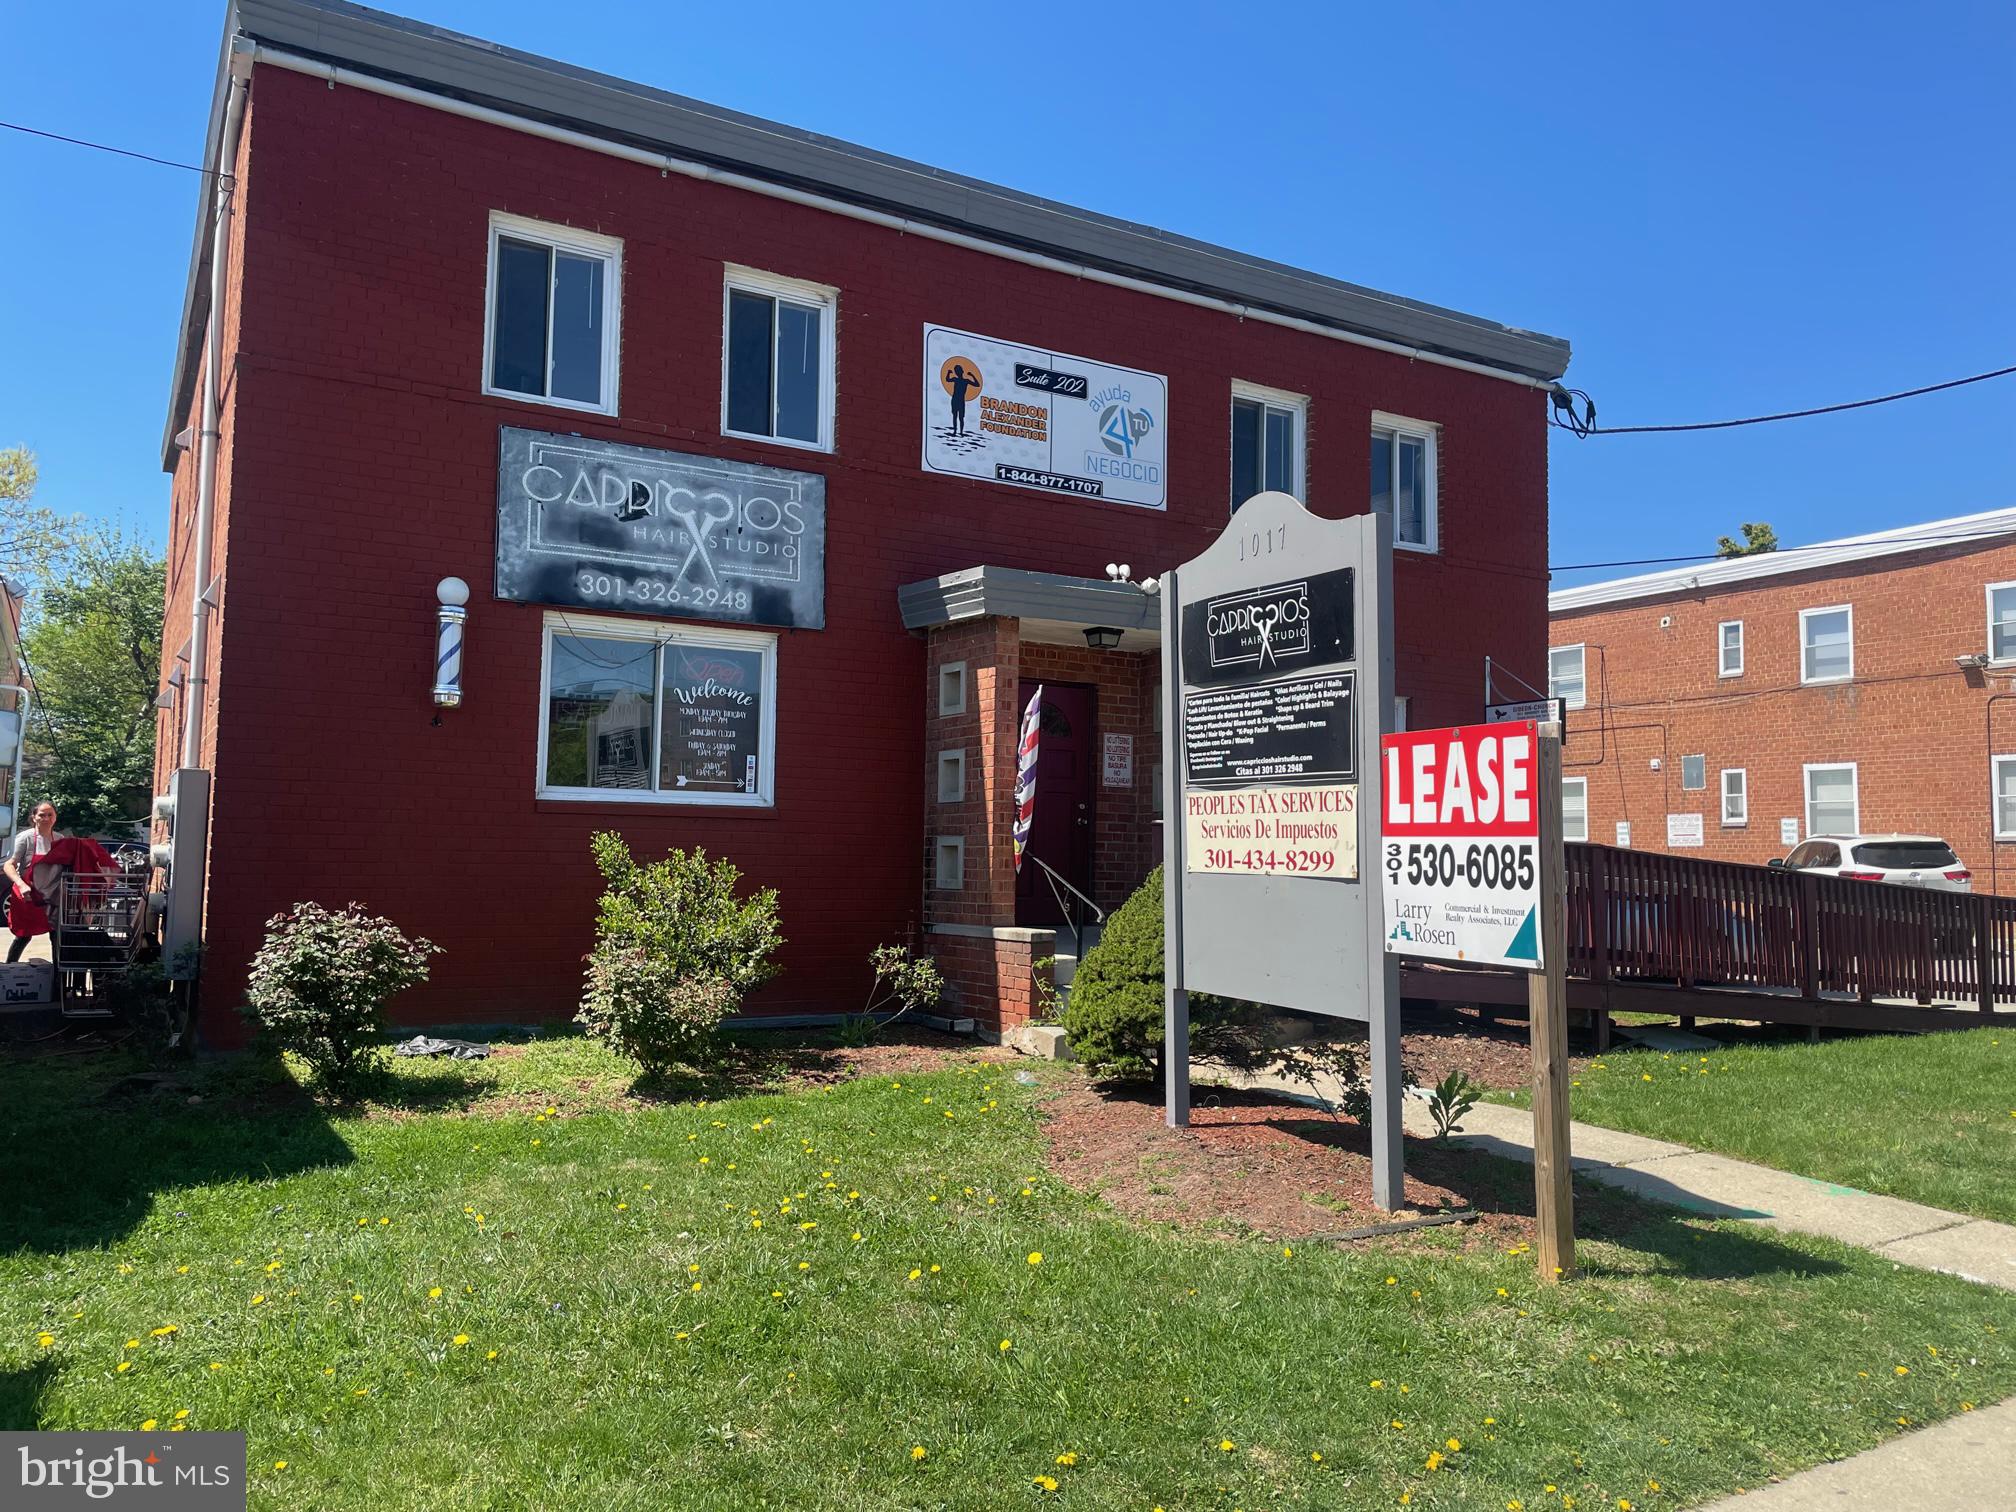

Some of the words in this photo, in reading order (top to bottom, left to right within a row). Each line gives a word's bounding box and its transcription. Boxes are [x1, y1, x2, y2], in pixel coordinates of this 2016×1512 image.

[1016, 368, 1050, 386] Suite
[1055, 378, 1085, 394] 202
[980, 396, 1048, 420] BRANDON
[1089, 384, 1131, 412] ayuda
[980, 409, 1047, 431] ALEXANDER
[1132, 419, 1148, 432] TU
[979, 421, 1047, 442] FOUNDATION
[1087, 455, 1159, 483] NEGOCIO
[998, 468, 1101, 494] 1-844-877-1707
[633, 526, 690, 545] HAIR
[708, 535, 797, 559] STUDIO
[1239, 523, 1286, 562] 1017
[580, 574, 748, 611] 301-326-2948
[1206, 596, 1311, 637] CAPRICCIOS
[1240, 635, 1262, 647] HAIR
[1268, 627, 1307, 643] STUDIO
[673, 677, 753, 706] Welcome
[1250, 689, 1271, 699] Haircuts
[1291, 691, 1317, 703] Highlights
[1317, 690, 1323, 699] &
[1323, 689, 1350, 699] Balayage
[1314, 681, 1324, 690] Gel
[1216, 712, 1224, 720] de
[1223, 711, 1239, 719] Botox
[1244, 708, 1263, 717] Keratin
[1243, 700, 1251, 708] de
[1292, 704, 1300, 713] up
[1300, 702, 1305, 710] &
[1304, 700, 1321, 710] Beard
[1321, 699, 1335, 708] Trim
[1233, 719, 1247, 727] Blow
[1246, 718, 1257, 726] out
[1261, 714, 1295, 725] Straightening
[1254, 725, 1269, 734] Facial
[1309, 720, 1327, 729] Perms
[1220, 738, 1232, 746] Cera
[1235, 767, 1253, 776] Citas
[1253, 766, 1261, 775] al
[1261, 765, 1274, 775] 301
[1274, 763, 1286, 774] 326
[1287, 763, 1304, 773] 2948
[1388, 735, 1531, 825] LEASE
[1188, 794, 1245, 816] PEOPLES
[1248, 792, 1278, 814] TAX
[1281, 790, 1354, 814] SERVICES
[1201, 818, 1251, 839] Servicios
[1255, 818, 1272, 839] De
[1275, 818, 1338, 845] Impuestos
[1204, 848, 1335, 873] 301-434-8299
[1386, 843, 1403, 885] 301
[1407, 843, 1535, 891] 530-6085
[1394, 898, 1432, 926] Larry
[1444, 902, 1482, 914] Commercial
[1483, 904, 1490, 914] &
[1491, 904, 1526, 917] Investment
[1445, 911, 1465, 924] Realty
[1467, 913, 1502, 927] Associates,
[1503, 916, 1519, 927] LLC
[1413, 923, 1457, 946] Rosen
